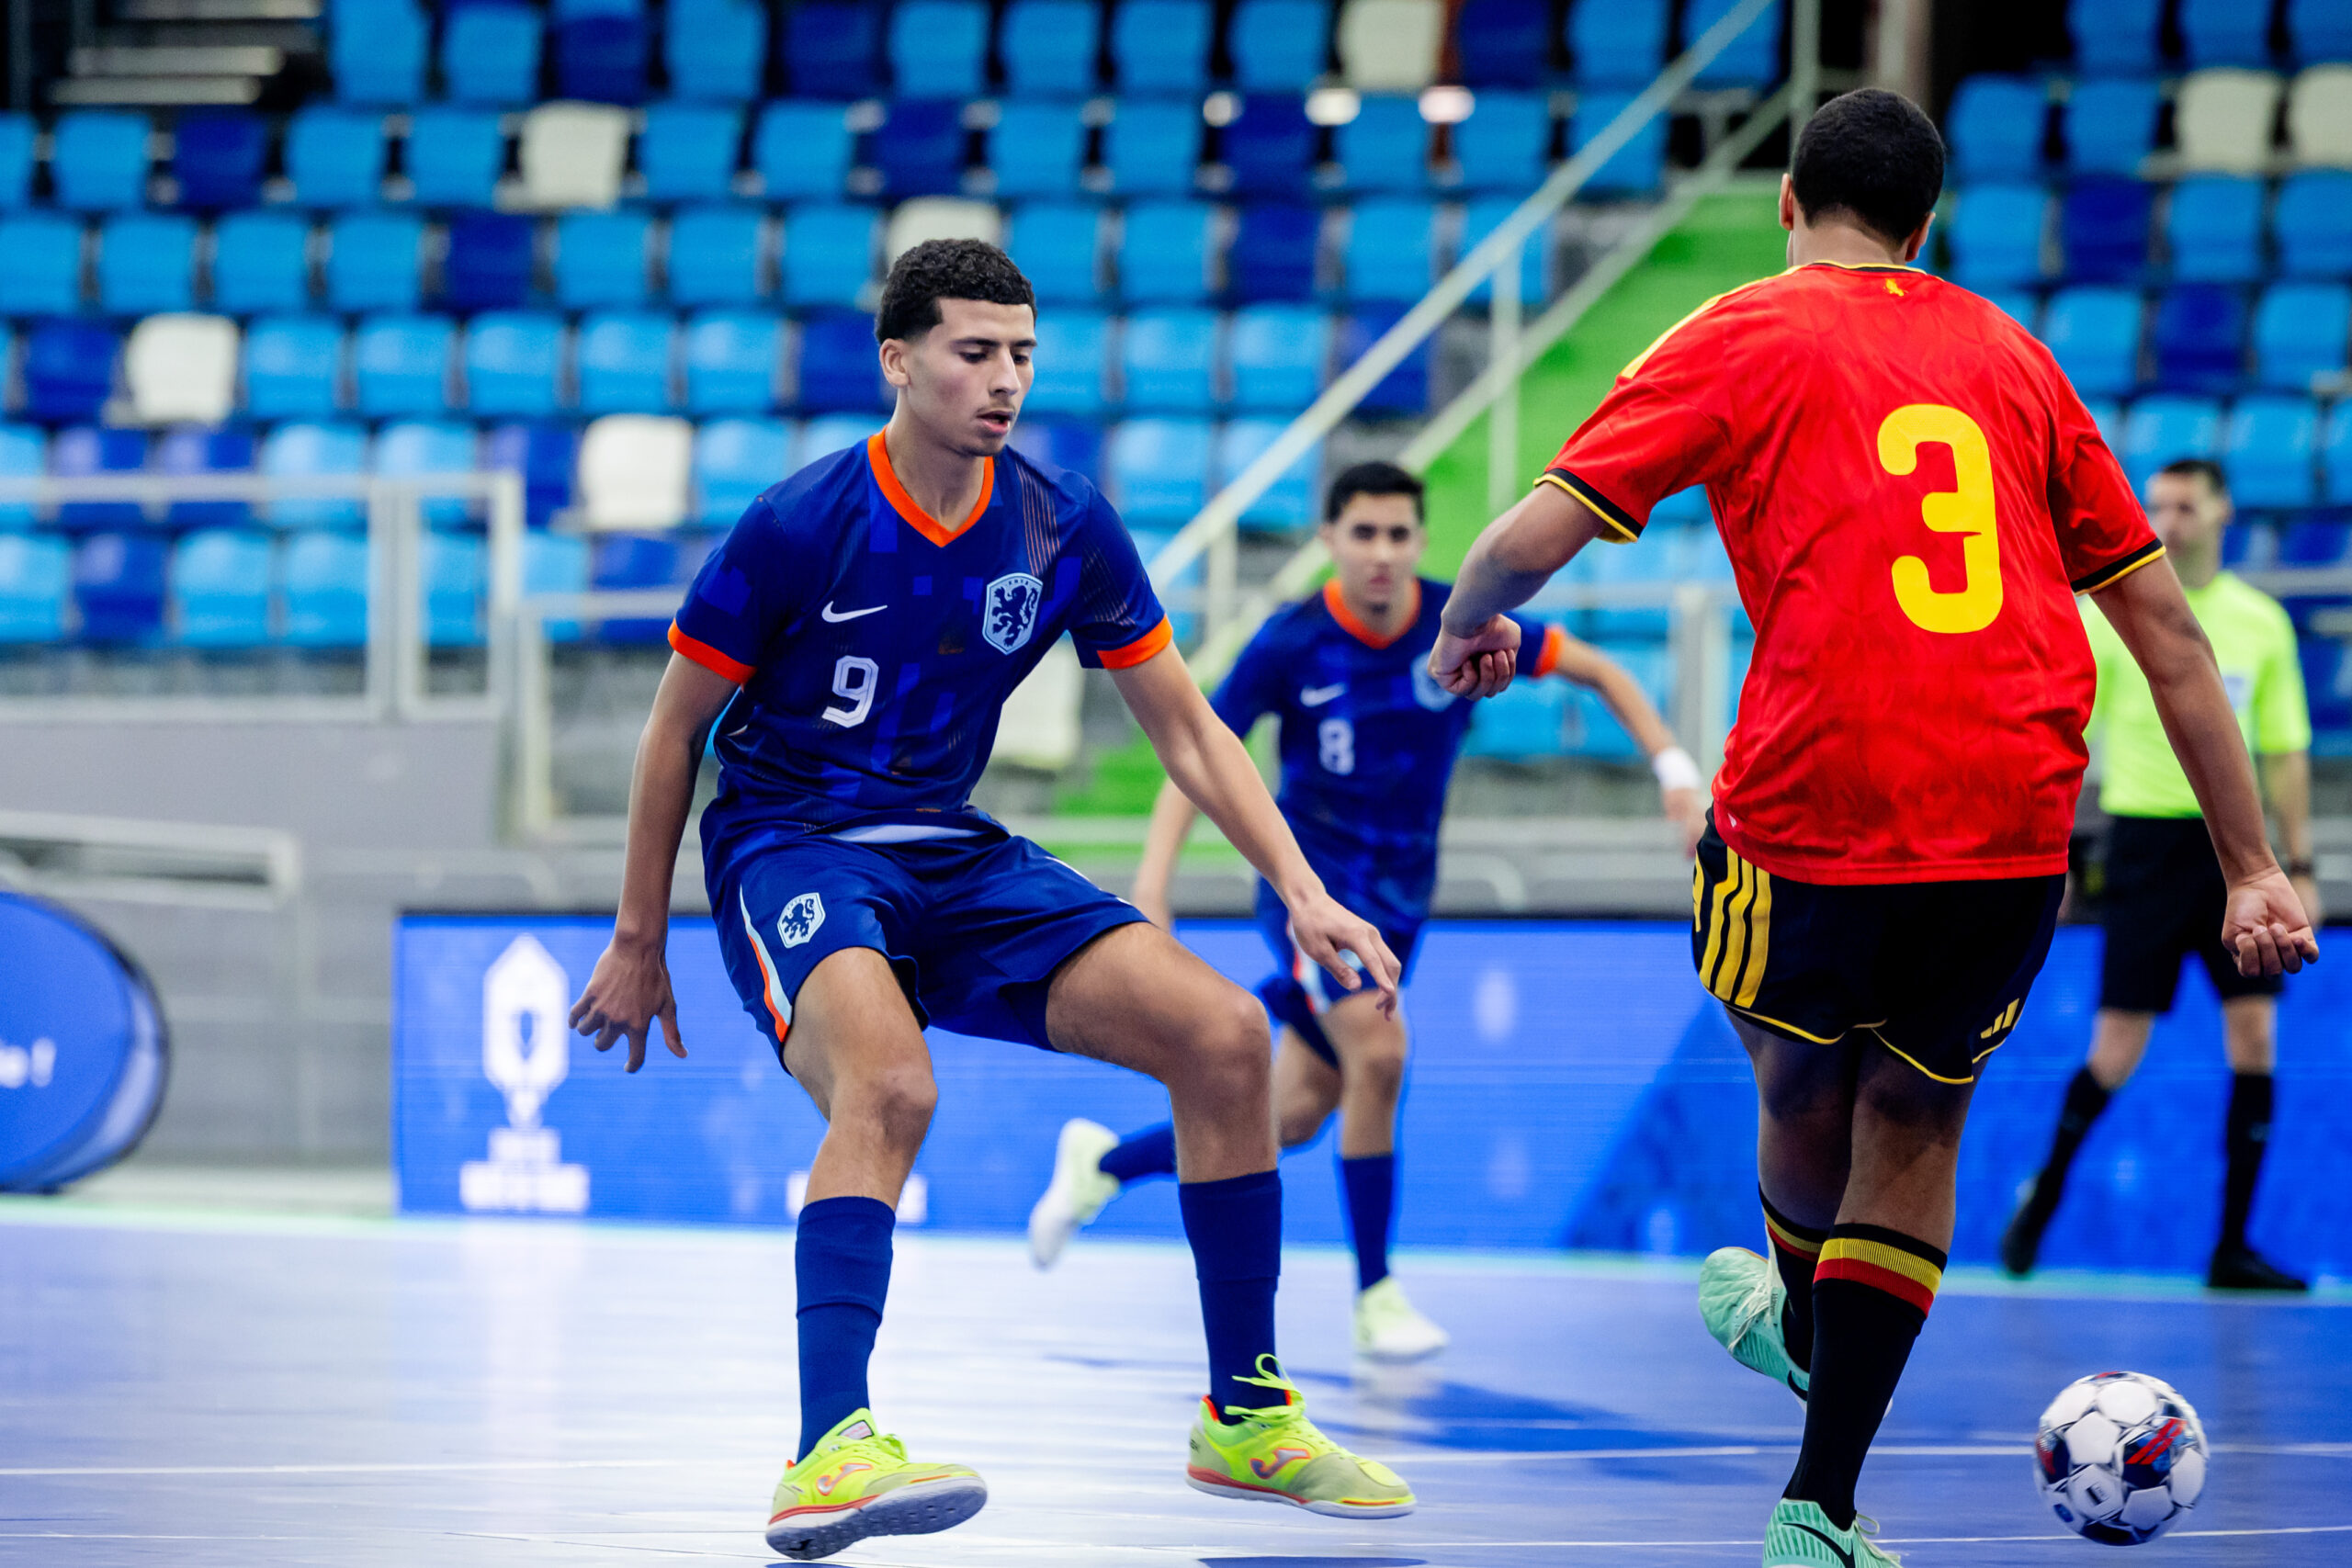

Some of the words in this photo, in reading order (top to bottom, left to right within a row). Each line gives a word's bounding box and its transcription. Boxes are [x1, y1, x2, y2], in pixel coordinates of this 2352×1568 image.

[1877, 403, 2004, 634] 3
[821, 655, 879, 728] 9
[1317, 717, 1355, 775] 8
